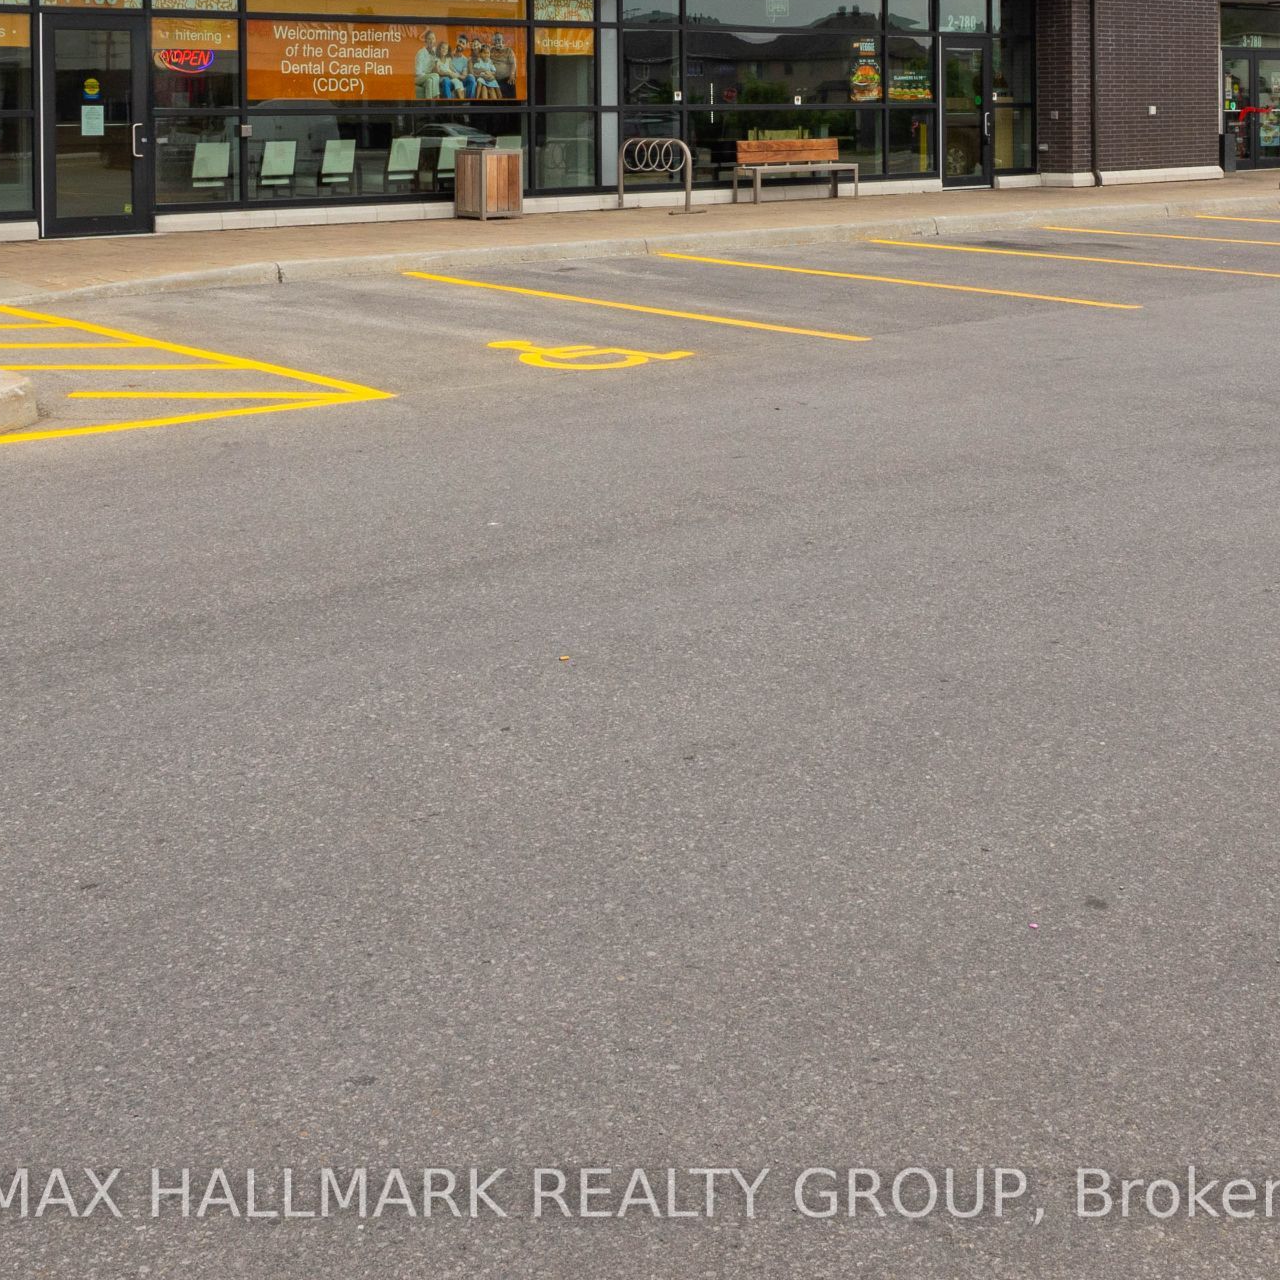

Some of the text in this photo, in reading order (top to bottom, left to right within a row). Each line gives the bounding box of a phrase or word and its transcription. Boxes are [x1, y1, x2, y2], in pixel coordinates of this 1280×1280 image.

[948, 15, 977, 30] 2-780
[273, 25, 347, 44] Welcoming
[351, 28, 401, 46] patients
[1242, 35, 1262, 48] 3-780
[285, 44, 389, 59] of the Canadian
[281, 60, 393, 75] Dental Care Plan
[313, 78, 365, 94] (CDCP)
